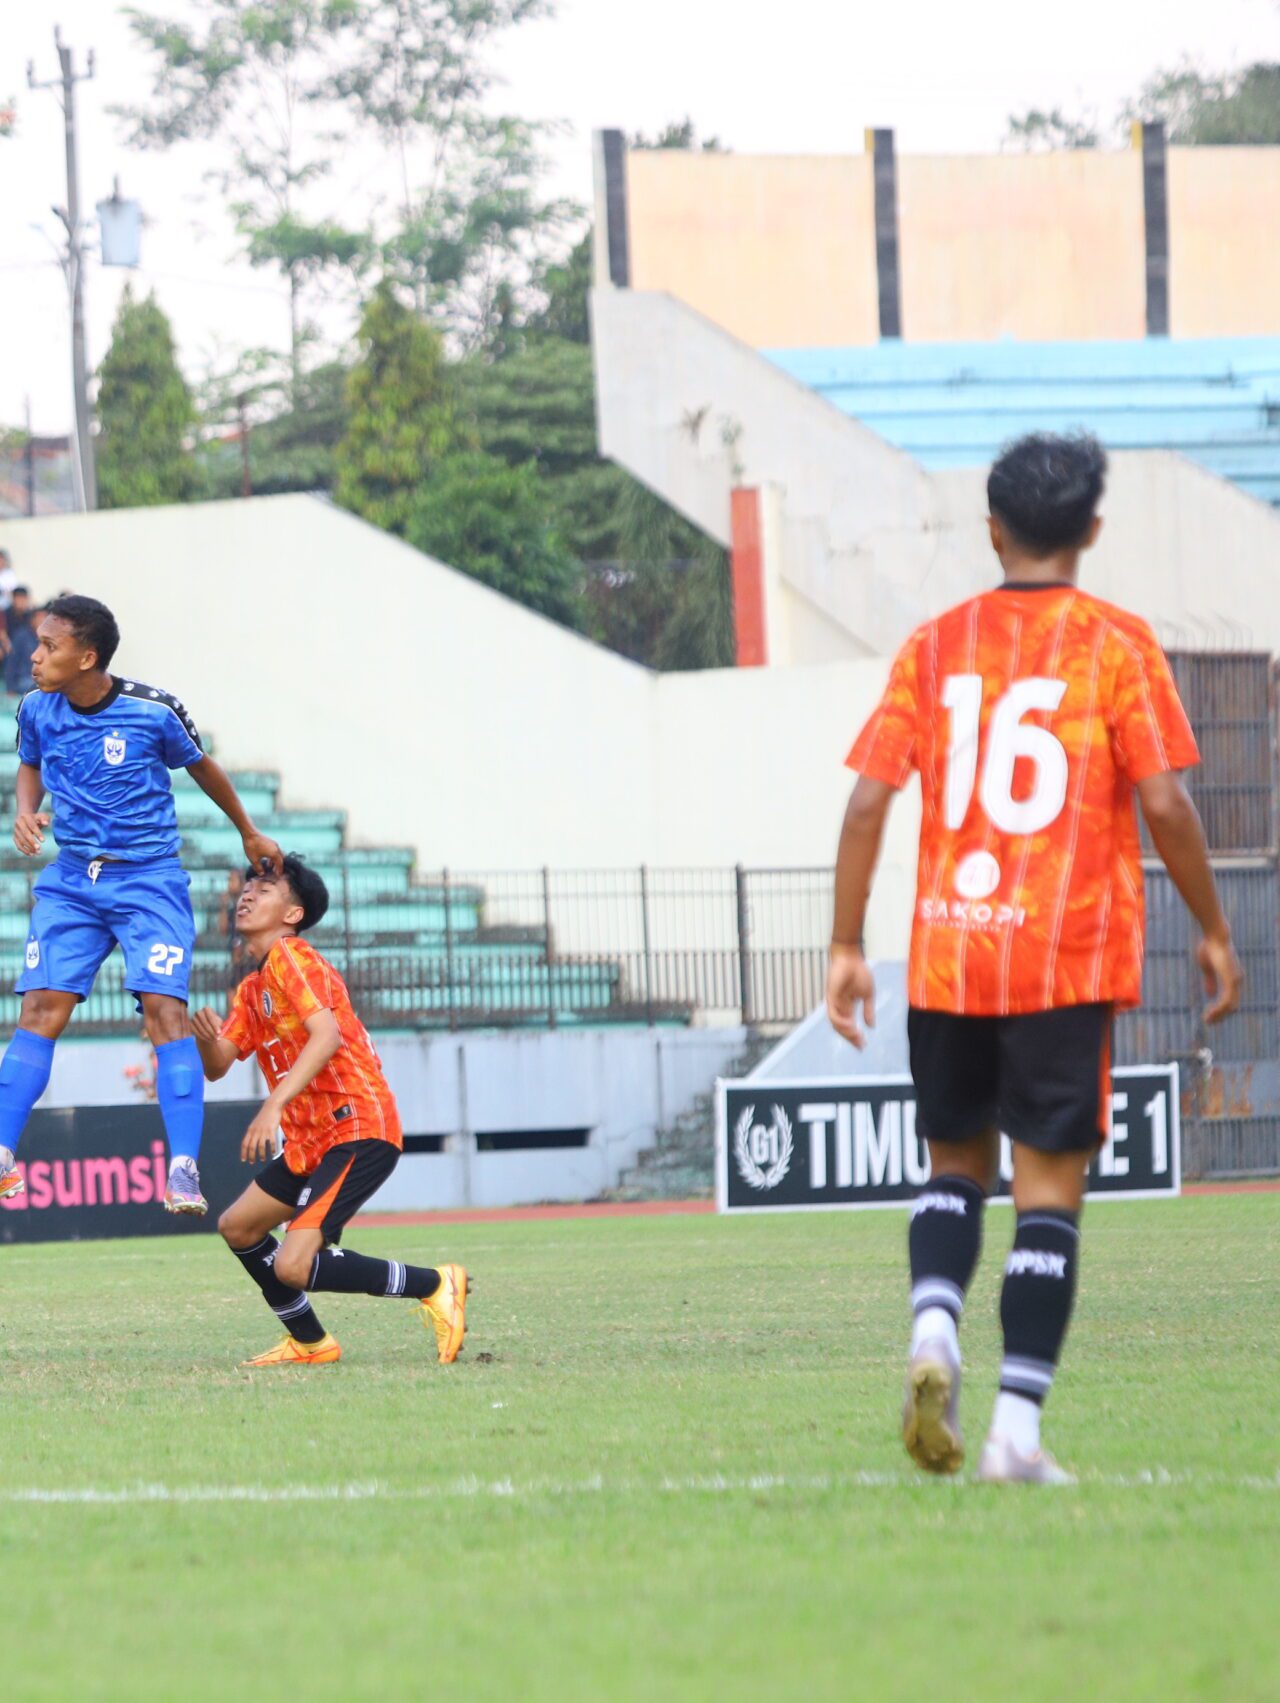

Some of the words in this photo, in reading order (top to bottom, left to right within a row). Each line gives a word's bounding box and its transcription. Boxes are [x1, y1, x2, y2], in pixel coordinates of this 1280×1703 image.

[942, 674, 1068, 834] 16
[922, 900, 1025, 928] SAKOPI
[148, 943, 184, 976] 27
[751, 1124, 780, 1165] G1
[798, 1100, 932, 1189] TIMU
[1144, 1091, 1168, 1174] 1
[0, 1140, 167, 1210] asumsi
